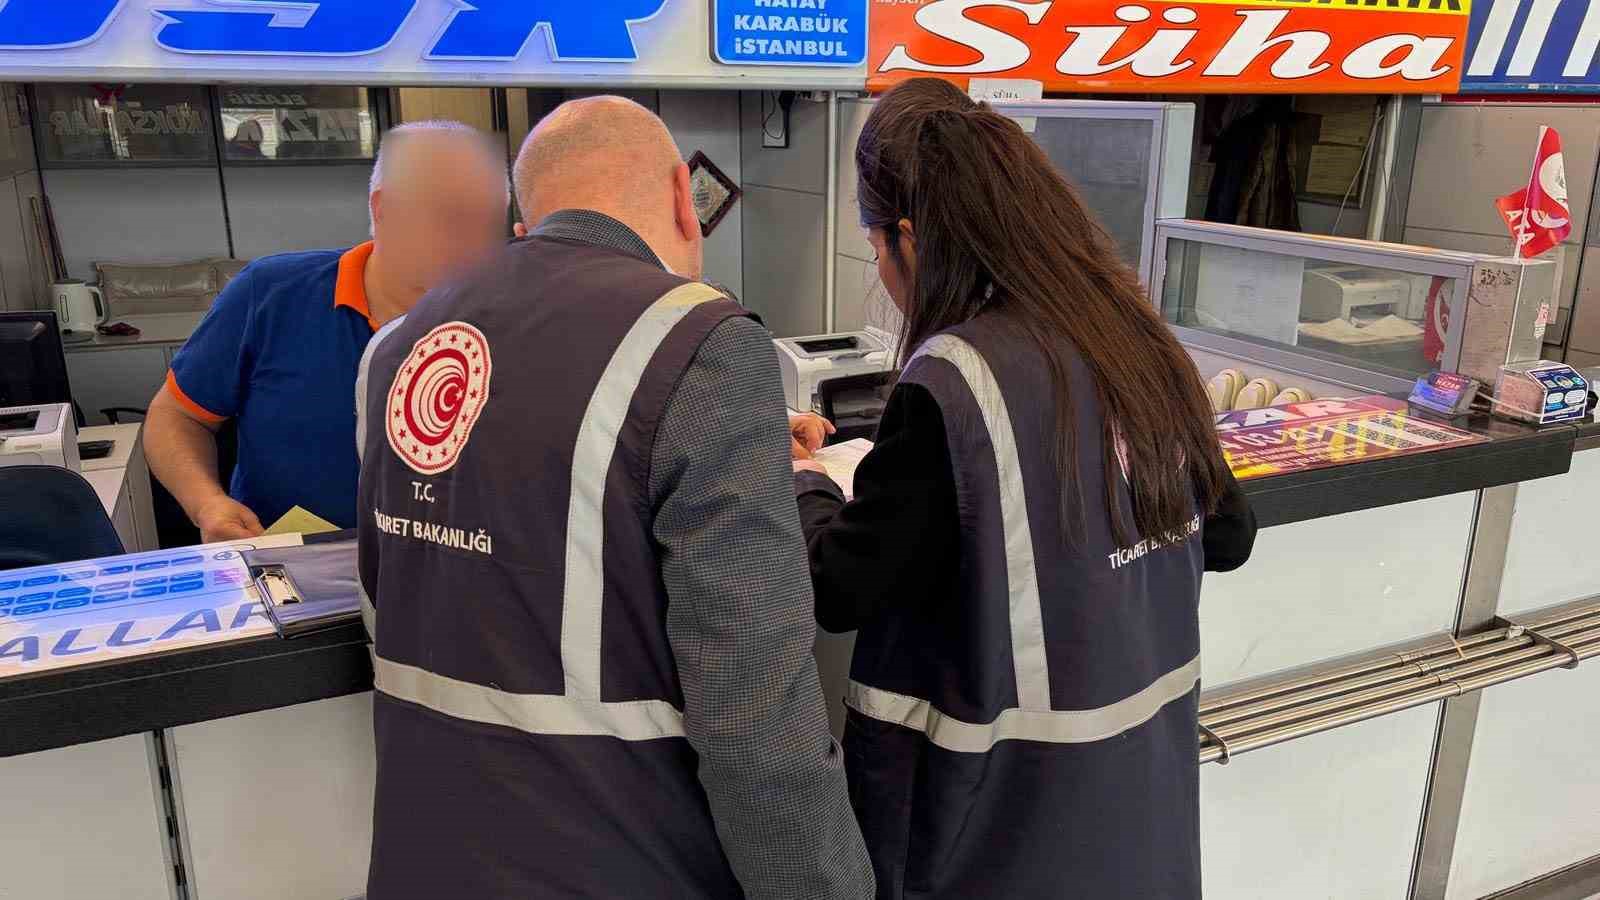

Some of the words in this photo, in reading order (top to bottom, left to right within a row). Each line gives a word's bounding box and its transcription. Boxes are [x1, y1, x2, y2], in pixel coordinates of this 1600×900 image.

[734, 13, 849, 34] KARABÜK
[877, 0, 1457, 80] Süha
[411, 481, 436, 503] T.C.
[412, 521, 494, 554] BAKANLIĞI
[1108, 538, 1149, 570] TİCARET
